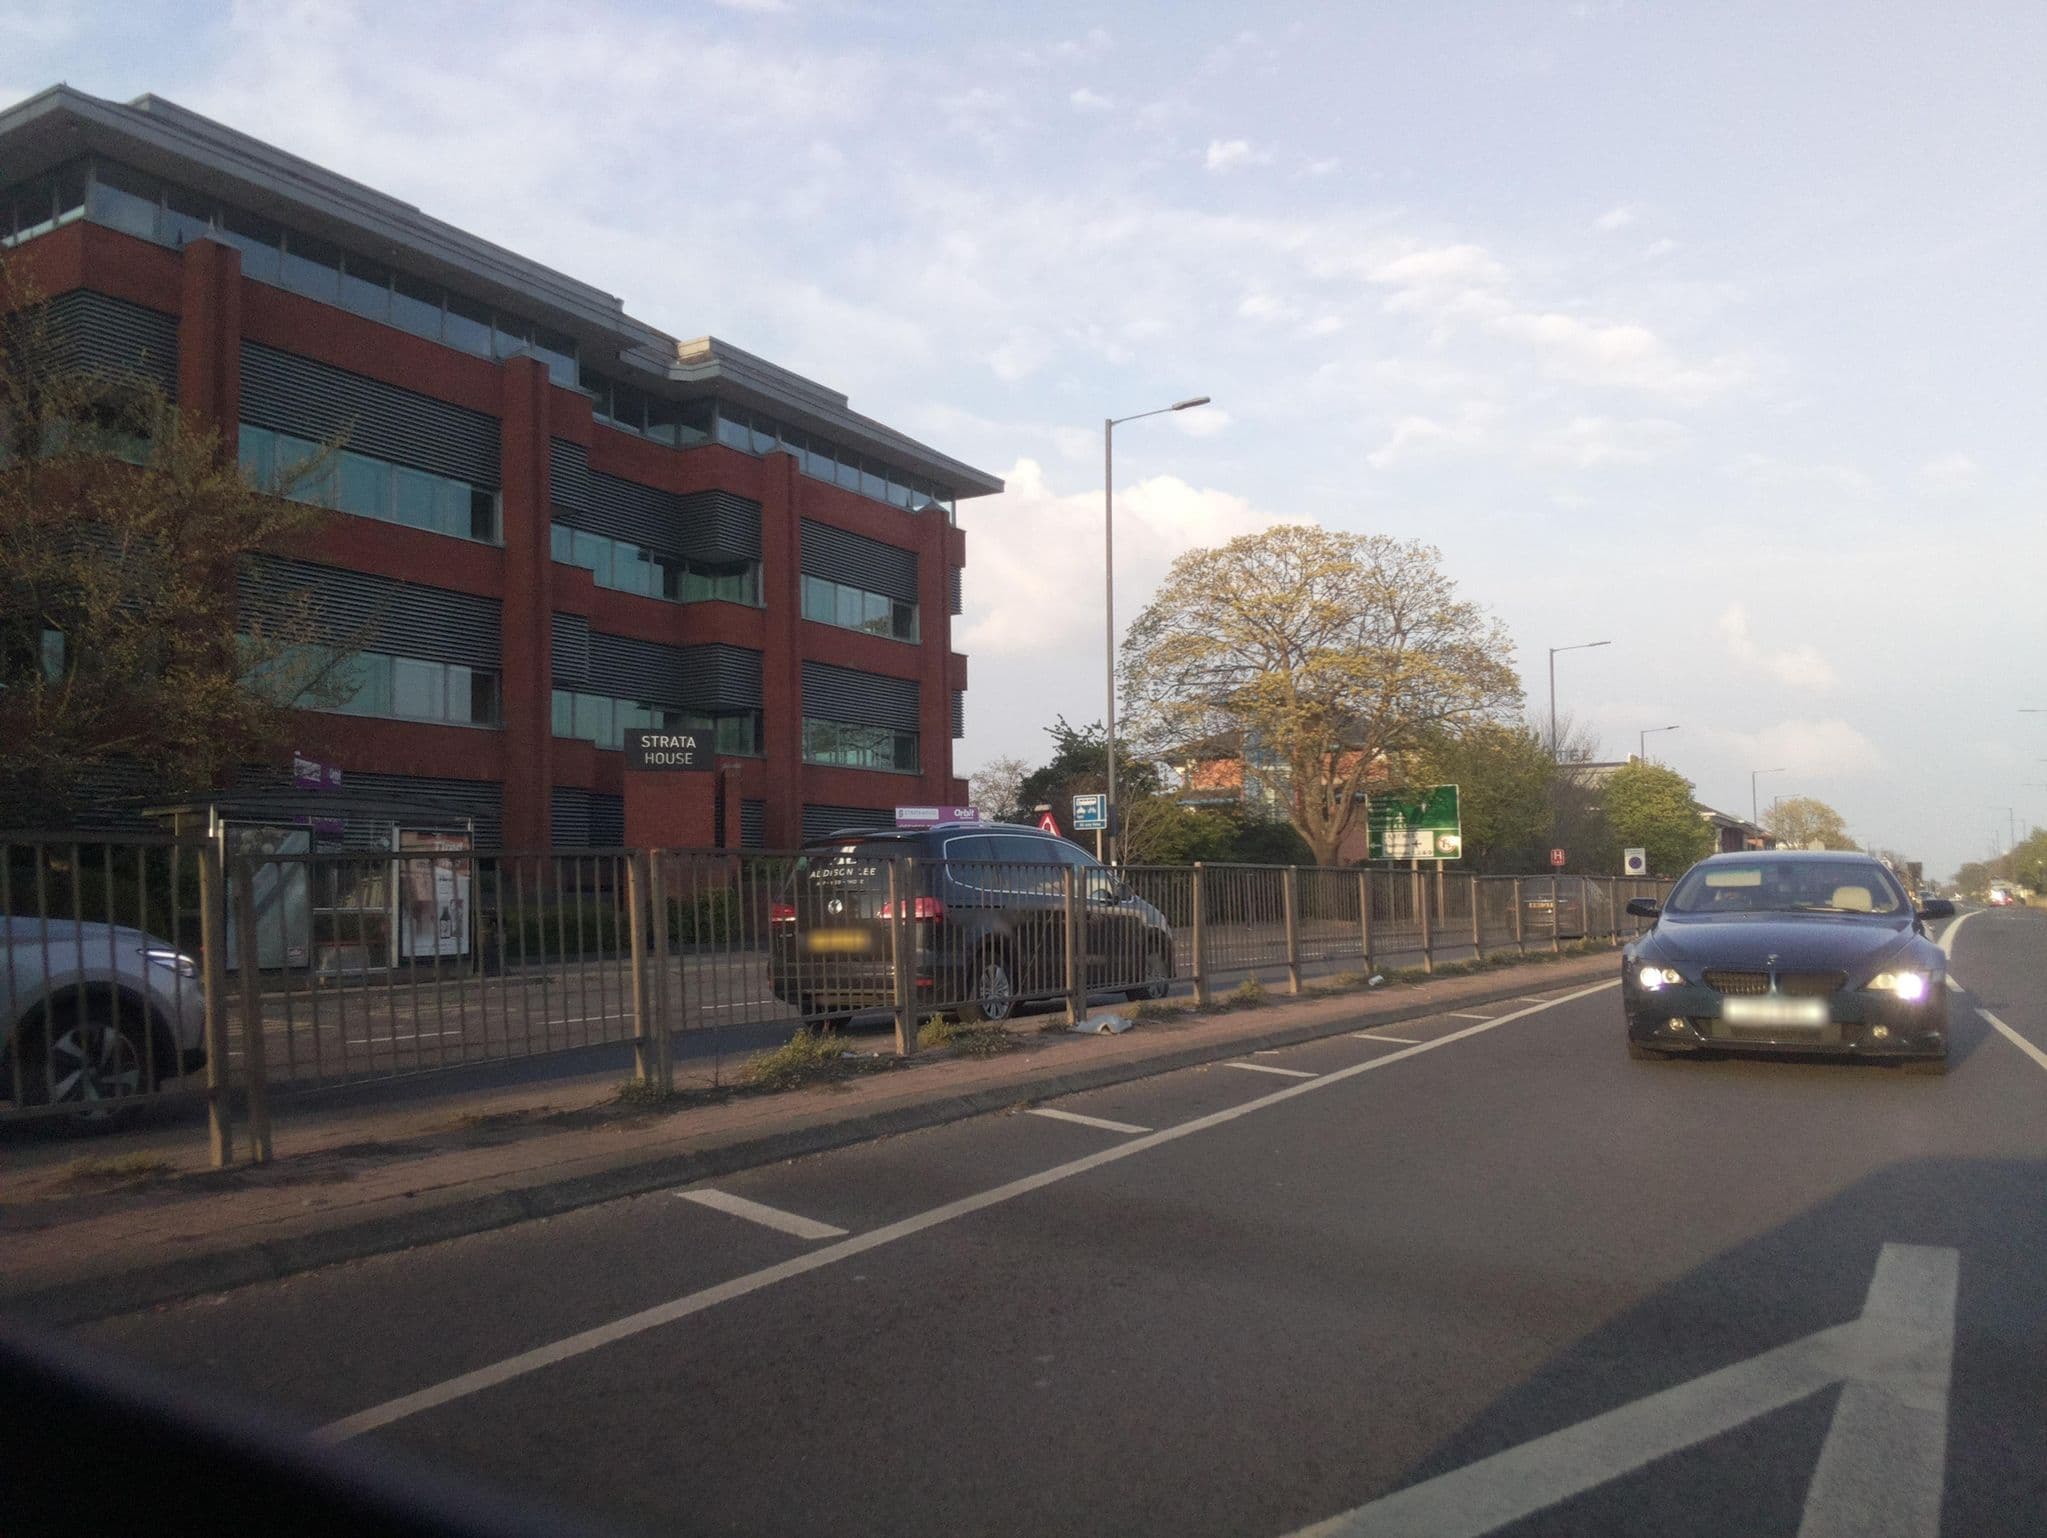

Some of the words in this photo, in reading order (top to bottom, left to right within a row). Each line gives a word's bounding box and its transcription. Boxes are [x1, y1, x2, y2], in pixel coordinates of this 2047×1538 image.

[641, 735, 696, 748] STRATA
[645, 752, 694, 765] HOUSE
[954, 808, 975, 817] Orbit
